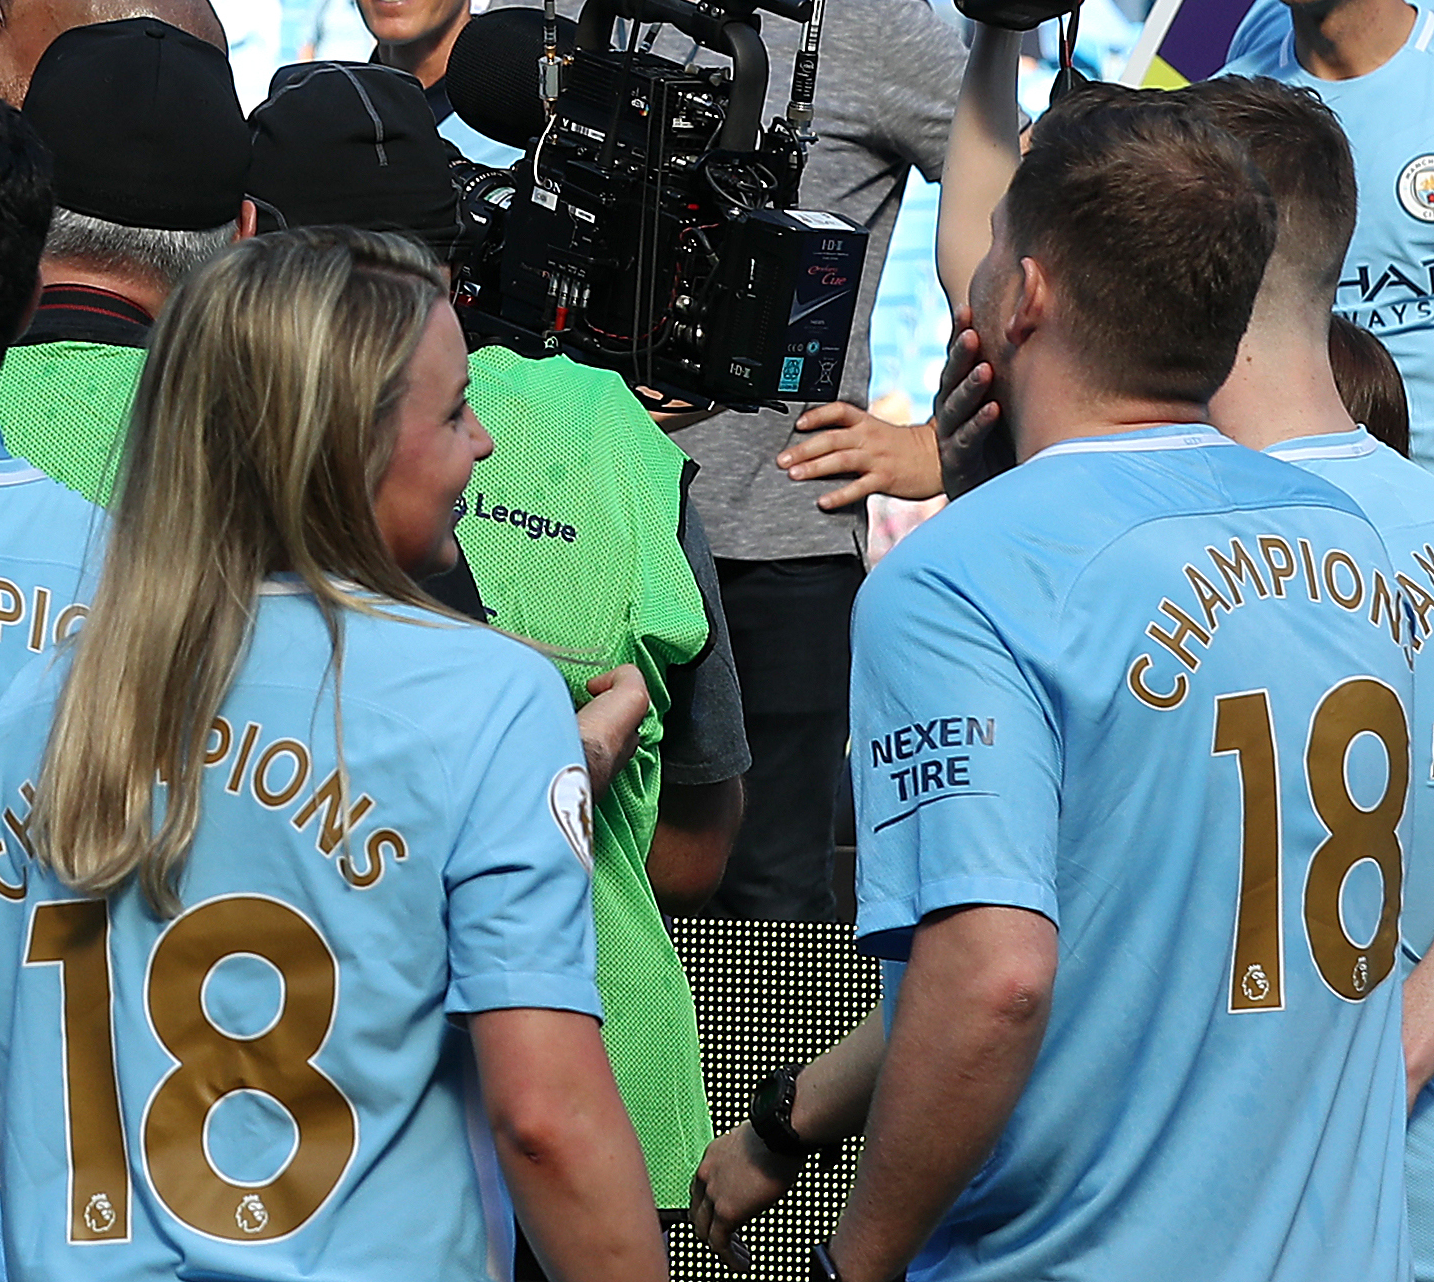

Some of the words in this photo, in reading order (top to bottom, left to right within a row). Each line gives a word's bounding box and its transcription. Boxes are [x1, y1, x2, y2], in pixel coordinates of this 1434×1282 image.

[476, 493, 577, 543] League
[871, 715, 996, 768] NEXEN
[890, 754, 970, 804] TIRE
[1211, 674, 1410, 1015] 18
[23, 892, 359, 1244] 18
